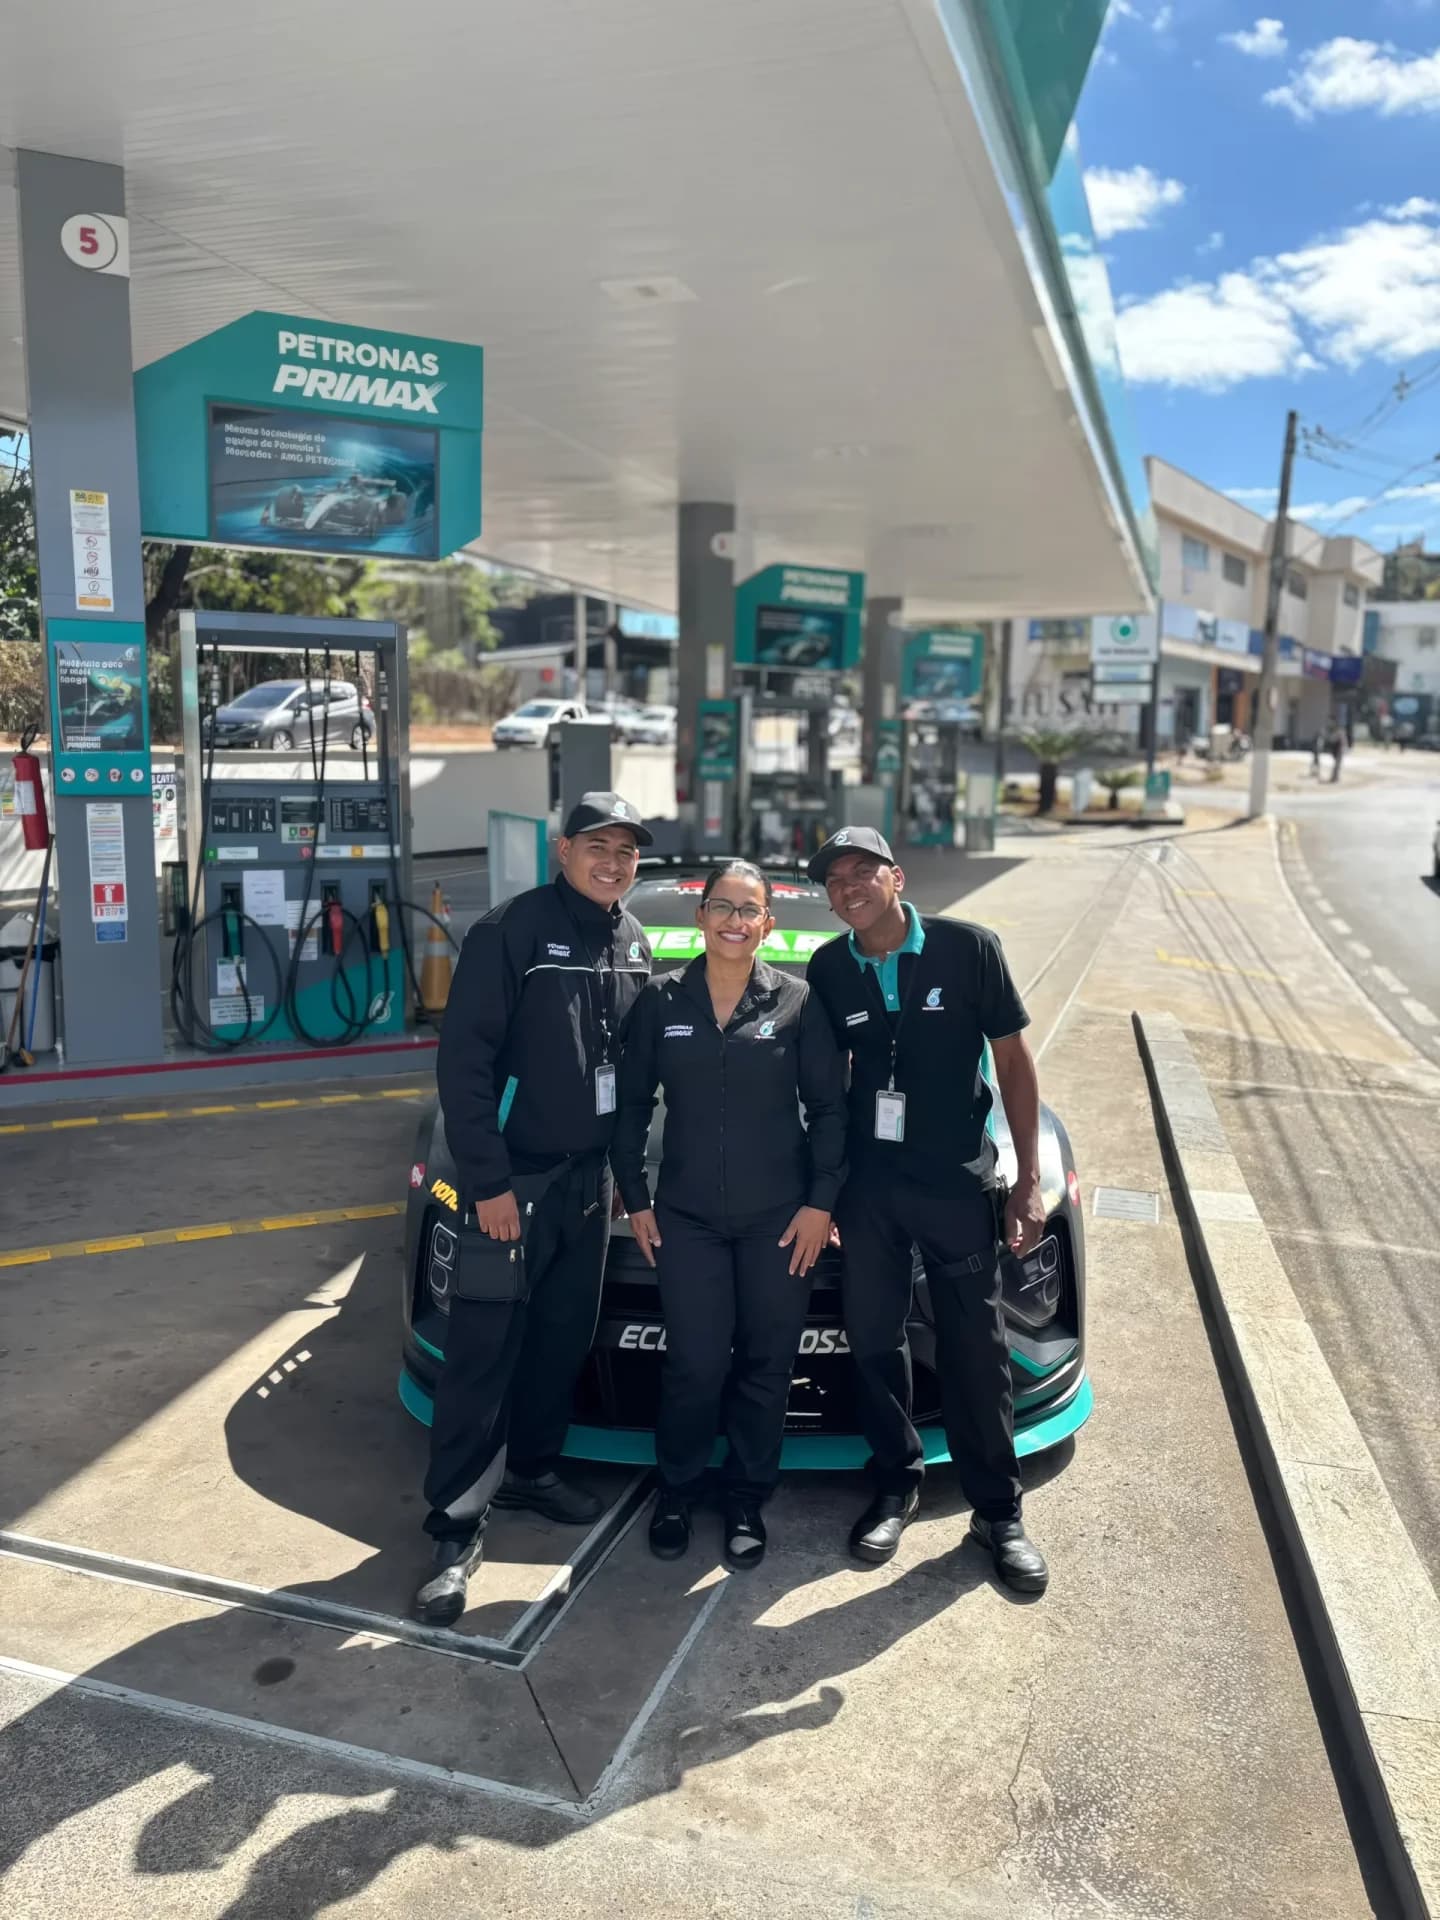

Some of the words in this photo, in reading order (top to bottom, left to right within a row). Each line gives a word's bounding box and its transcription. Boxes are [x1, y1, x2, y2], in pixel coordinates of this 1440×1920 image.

[79, 226, 99, 255] 5
[277, 330, 440, 377] PETRONAS
[272, 363, 448, 414] PRIMAX
